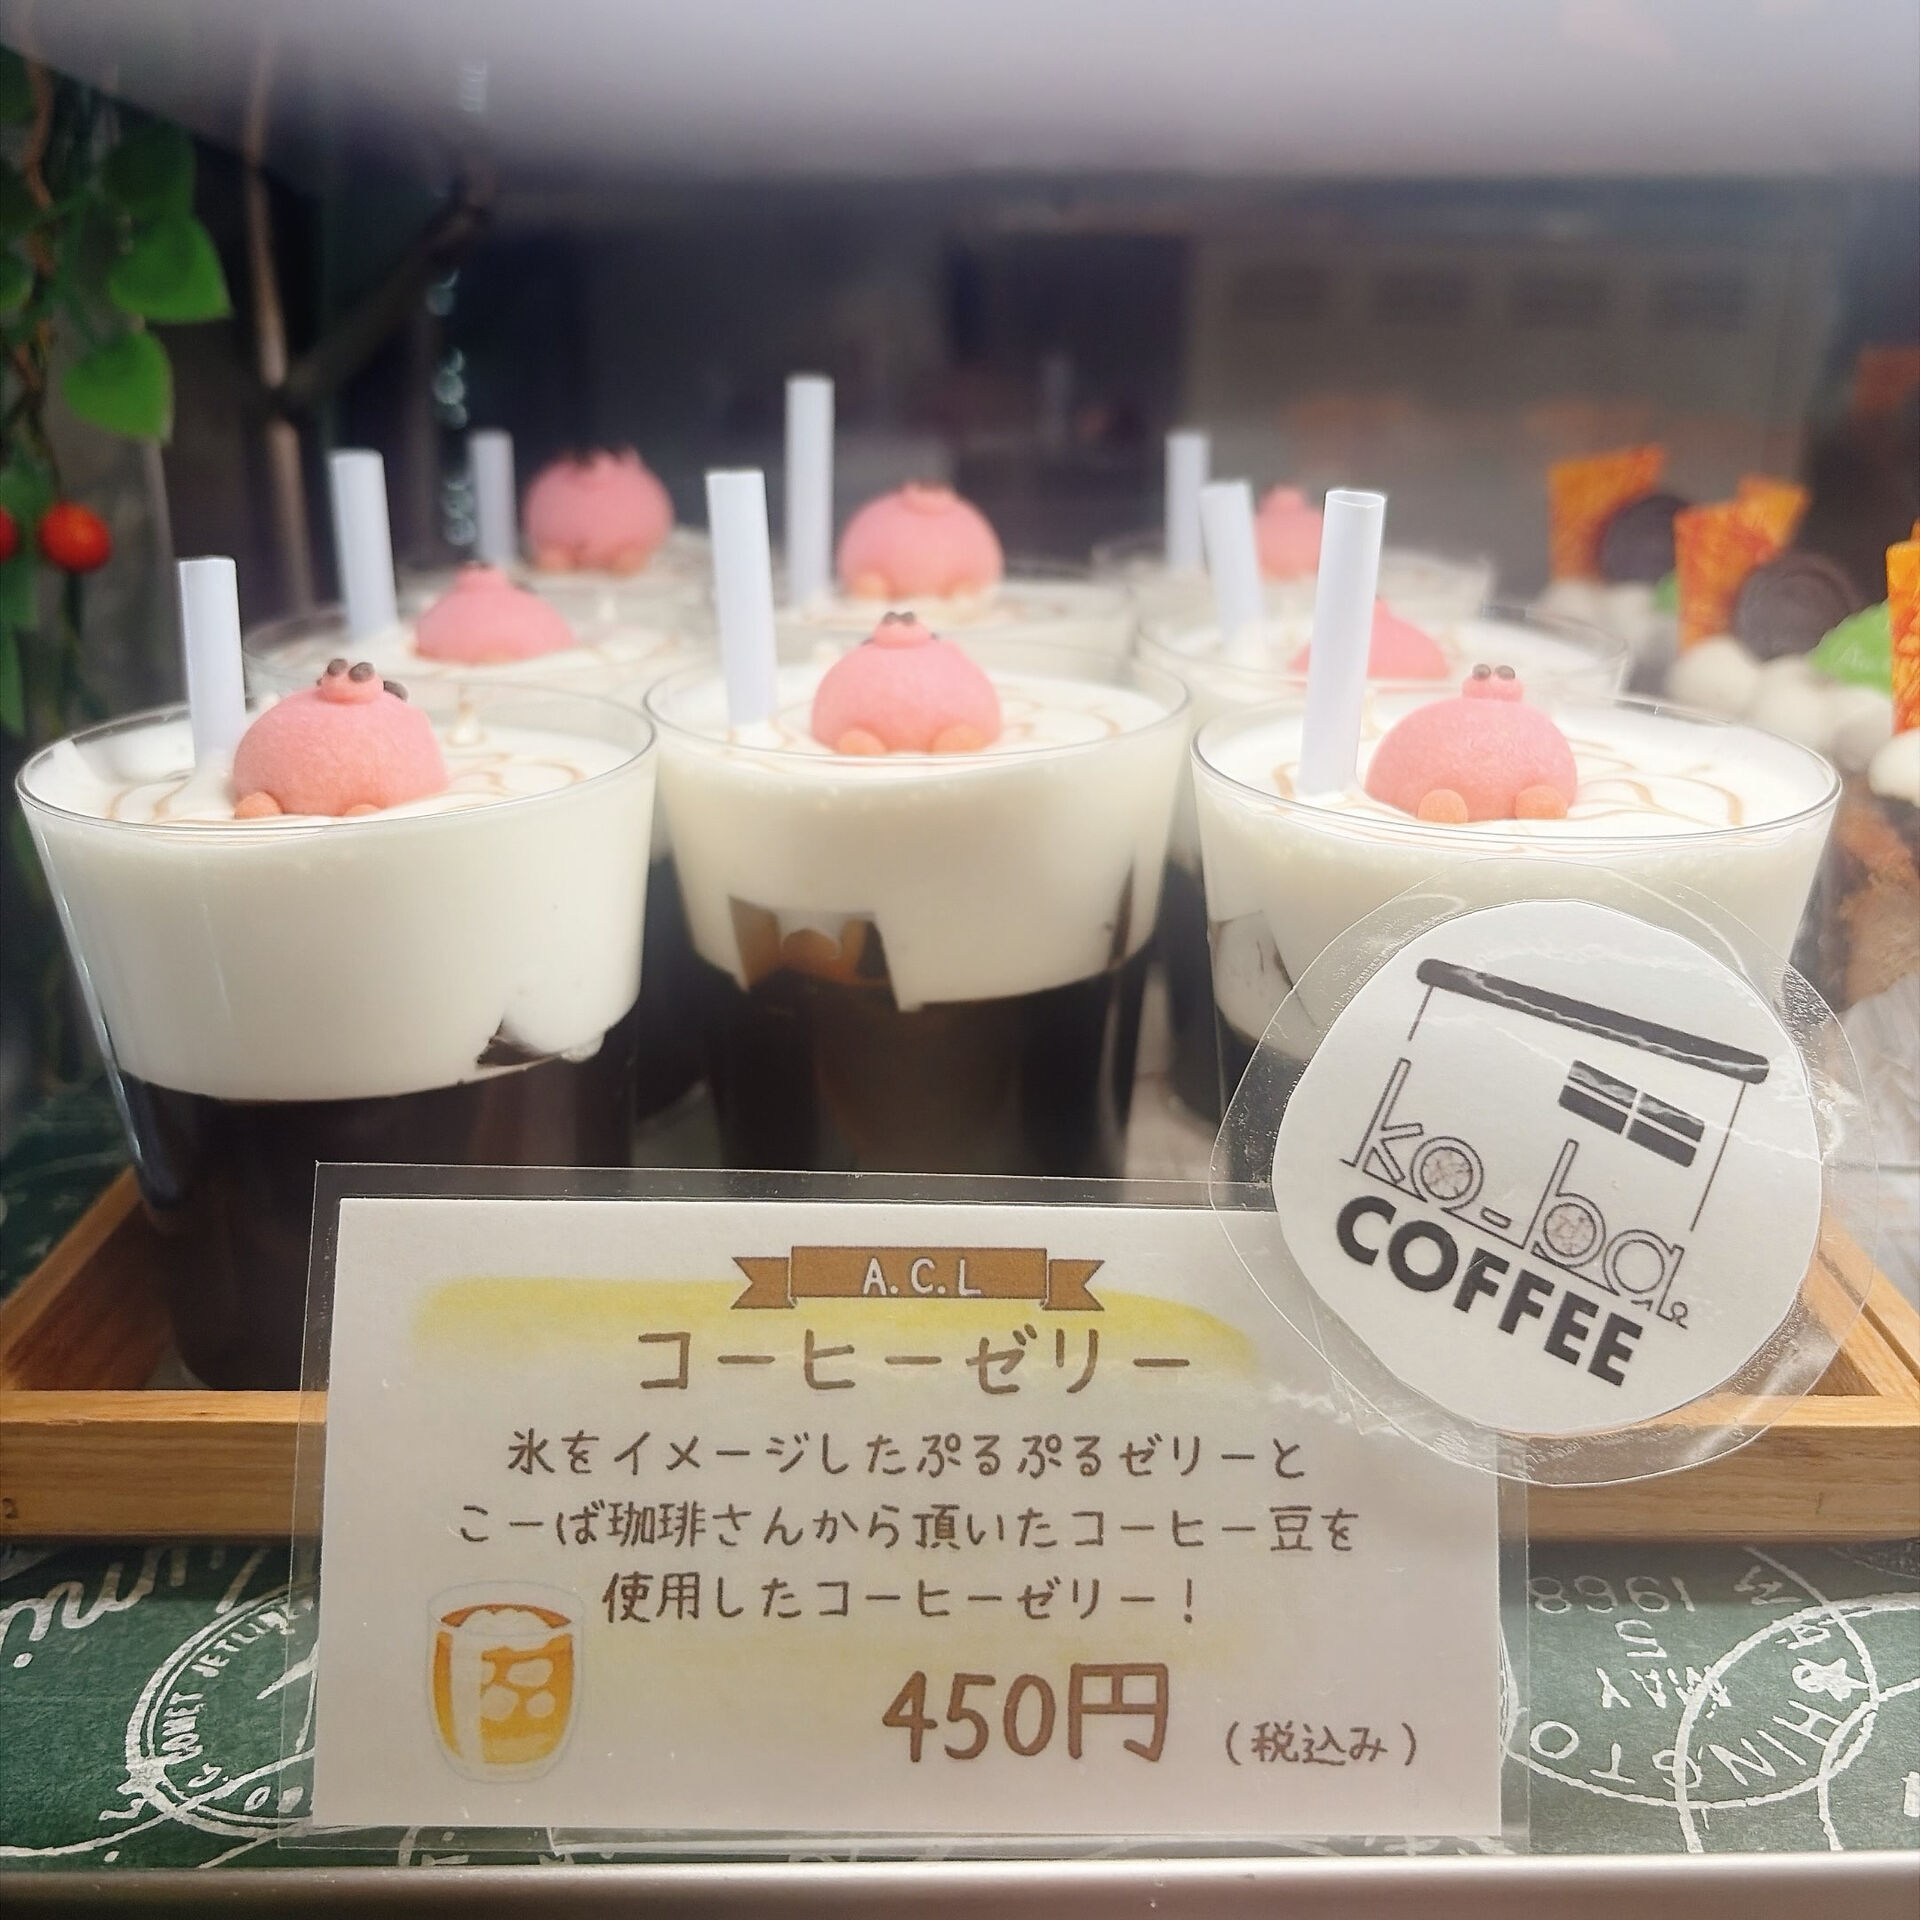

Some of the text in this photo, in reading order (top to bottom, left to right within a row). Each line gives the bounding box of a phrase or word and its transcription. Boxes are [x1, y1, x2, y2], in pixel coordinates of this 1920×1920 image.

[864, 1258, 982, 1297] A.C.L
[1337, 1195, 1643, 1387] COFFEE
[638, 1325, 1191, 1395] コーヒーゼリー
[508, 1428, 1305, 1479] 氷をイメージしたぷるぷるゼリーと
[459, 1500, 1359, 1551] こーば珈琲さんから頂いたコーヒー豆を
[602, 1572, 1193, 1623] 使用したコーヒーゼリー！
[1530, 1575, 1696, 1614] 1968
[1614, 1619, 1668, 1659] 5
[882, 1663, 1169, 1763] 450円
